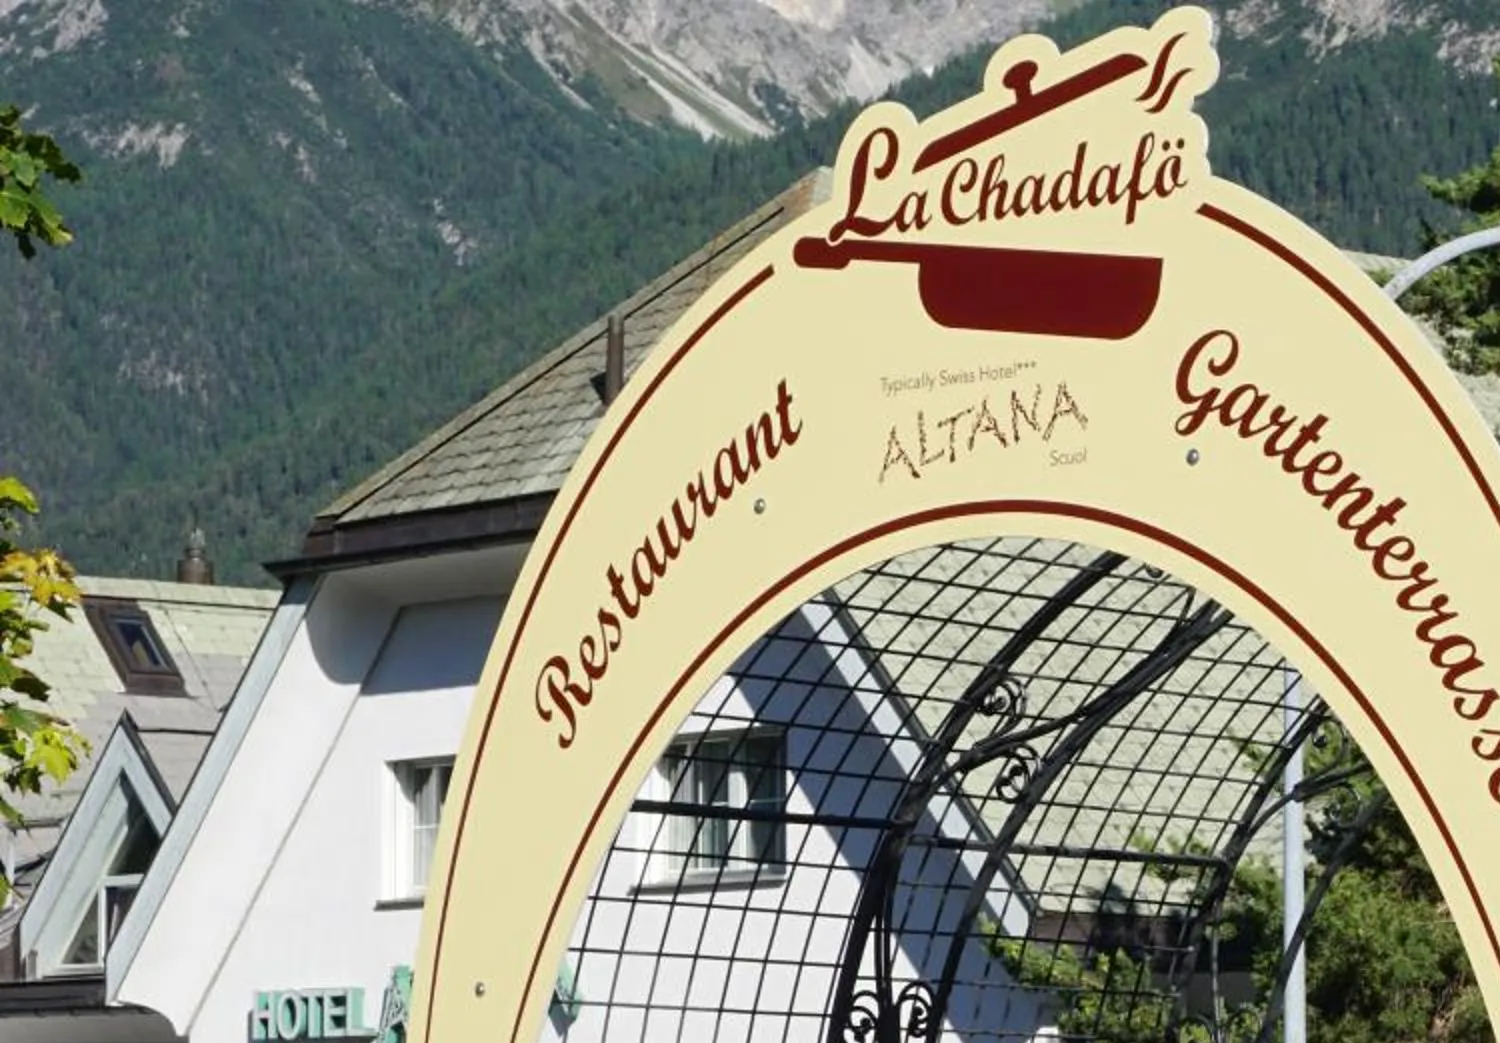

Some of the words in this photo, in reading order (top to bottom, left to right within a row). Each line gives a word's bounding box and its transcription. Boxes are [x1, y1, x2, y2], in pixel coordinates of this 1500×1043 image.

[828, 127, 932, 242] La
[940, 132, 1187, 225] Chadafö
[880, 376, 936, 398] Typically
[938, 368, 976, 387] Swiss
[878, 379, 1090, 484] ALTANA
[1049, 447, 1088, 467] Scuol
[535, 378, 803, 749] Restaurant
[251, 986, 378, 1040] HOTEL
